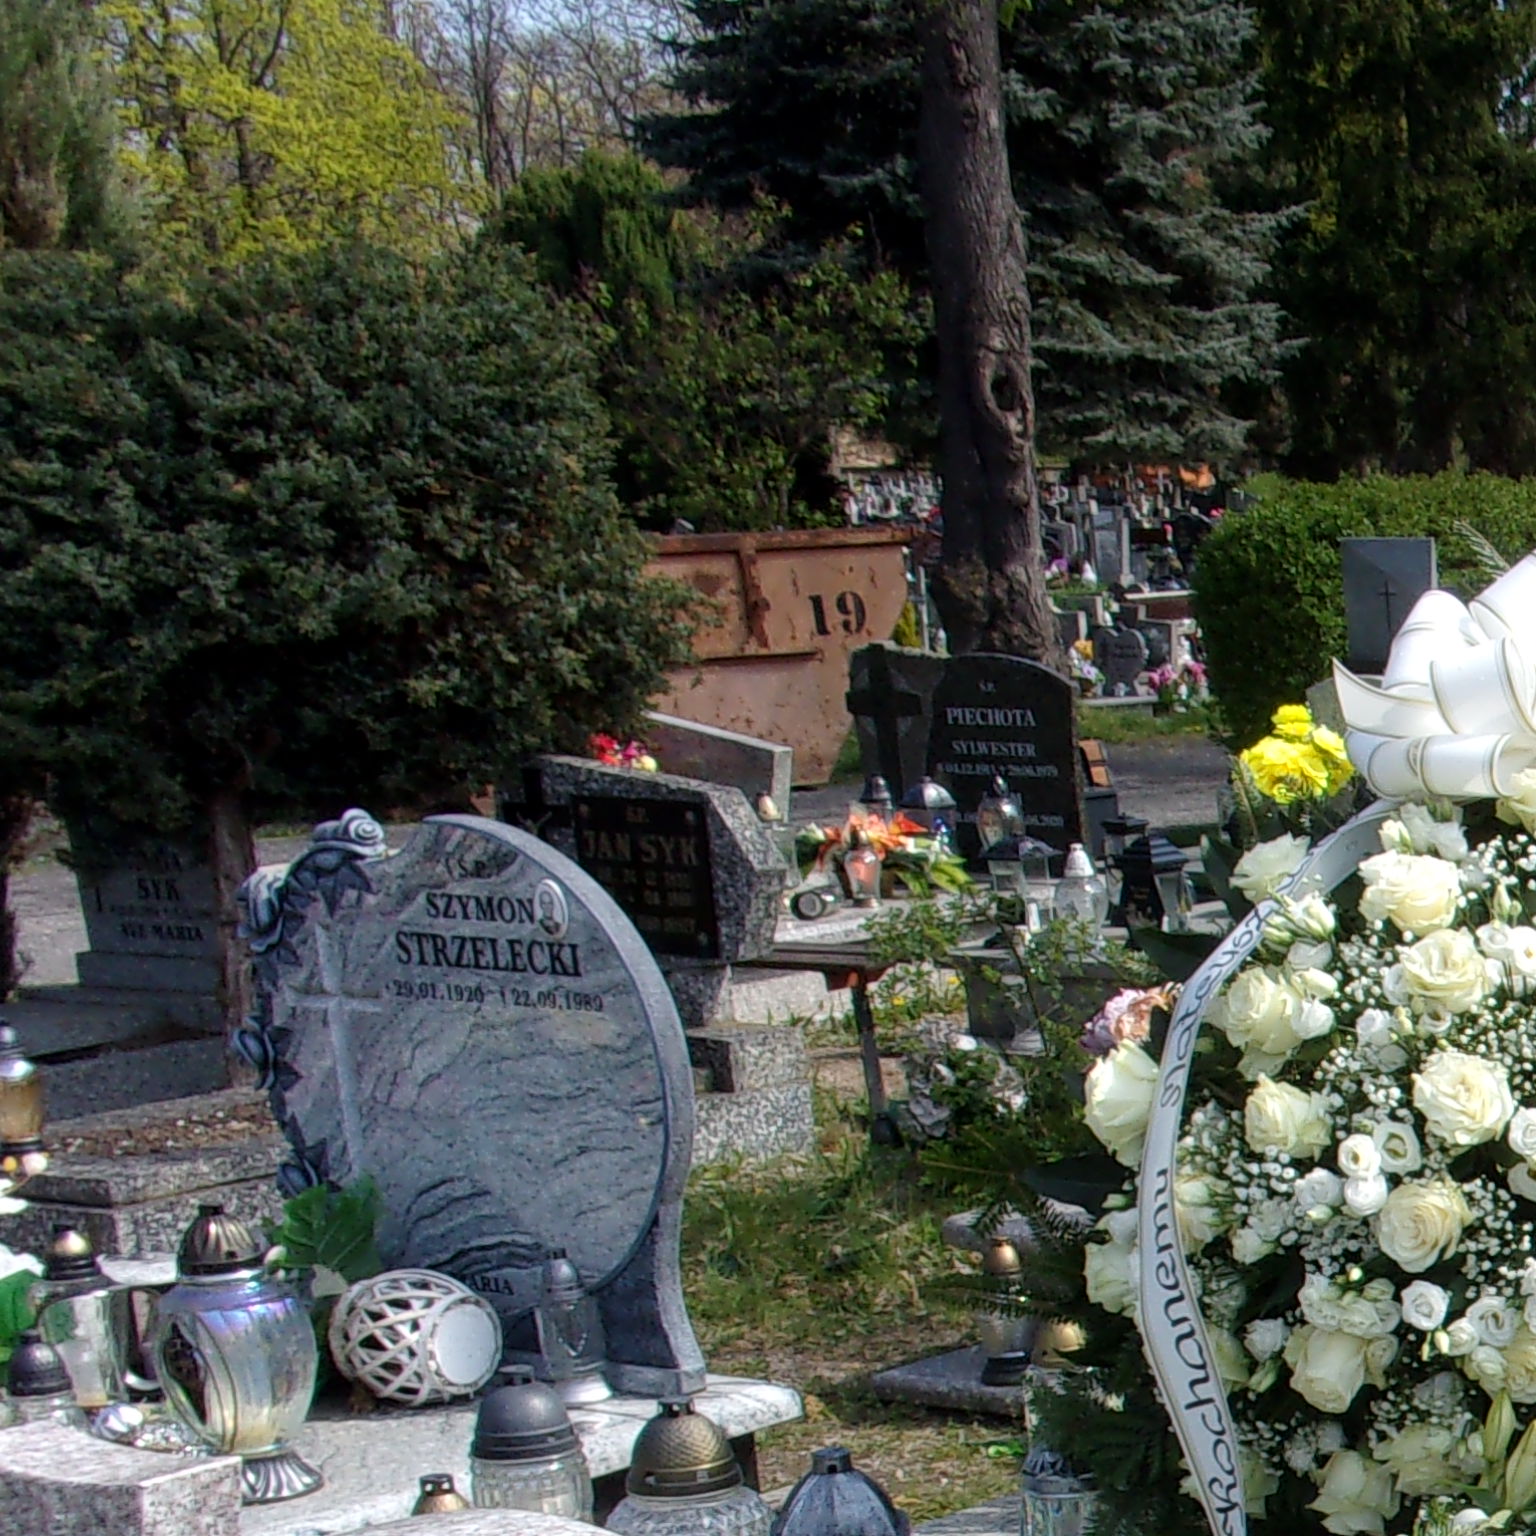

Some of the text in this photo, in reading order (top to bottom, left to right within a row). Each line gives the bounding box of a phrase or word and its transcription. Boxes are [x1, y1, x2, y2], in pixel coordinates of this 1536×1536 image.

[811, 593, 866, 636] 19
[946, 707, 1036, 728] PIECHOTA
[951, 739, 1036, 757] SYLWESTER
[582, 830, 698, 867] JAN SYK
[137, 877, 181, 901] SYK
[425, 892, 535, 925] SZYMON
[395, 930, 583, 977] STRZELECKI
